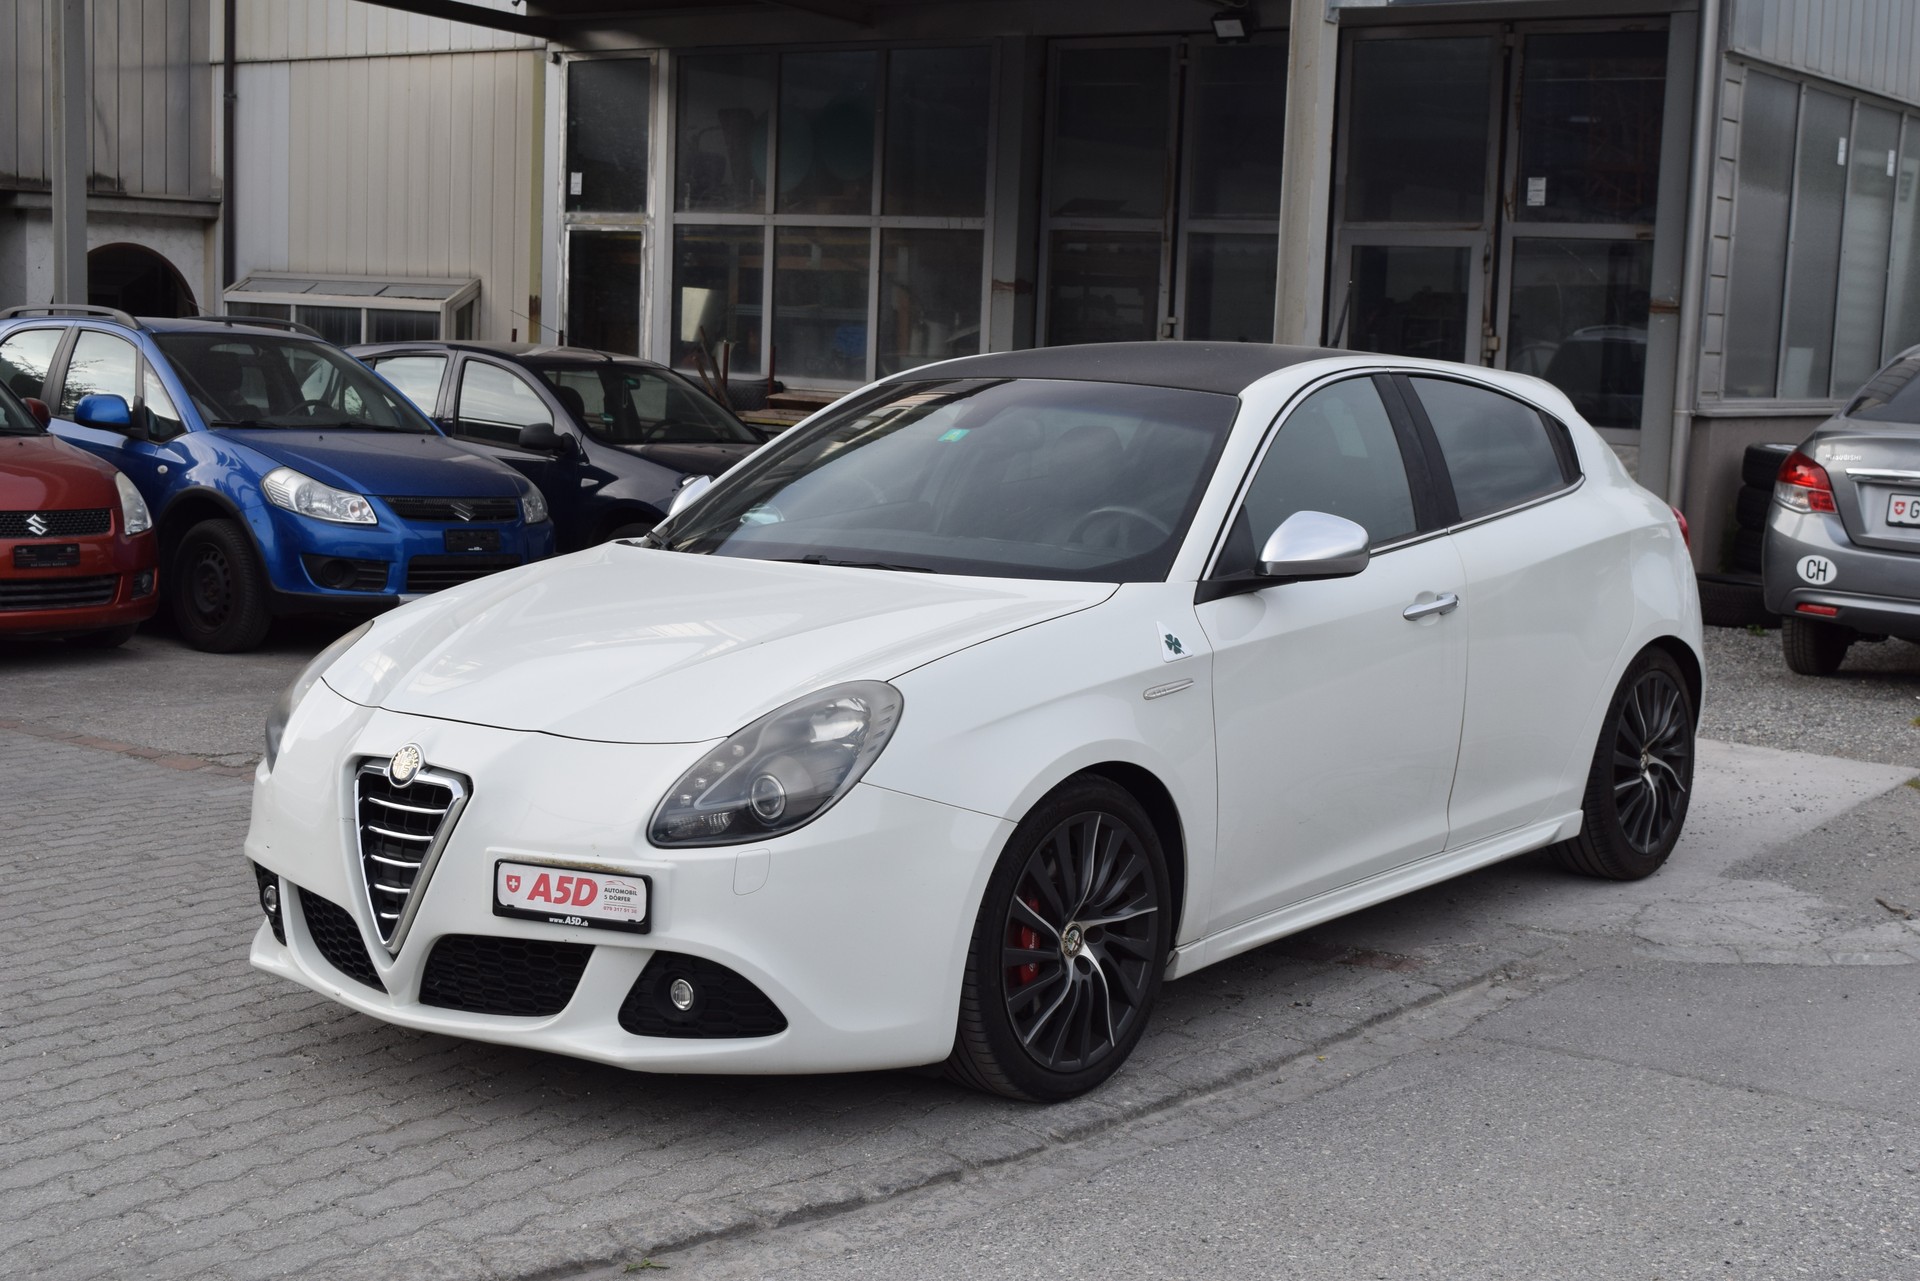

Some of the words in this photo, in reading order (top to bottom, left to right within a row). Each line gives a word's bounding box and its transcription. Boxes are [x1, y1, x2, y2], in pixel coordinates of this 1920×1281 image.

[1806, 560, 1828, 581] CH
[527, 873, 598, 907] A5D
[604, 887, 638, 896] AUTOMOBIL
[609, 894, 631, 902] DÖRFER
[549, 916, 589, 927] www.A5D.ch
